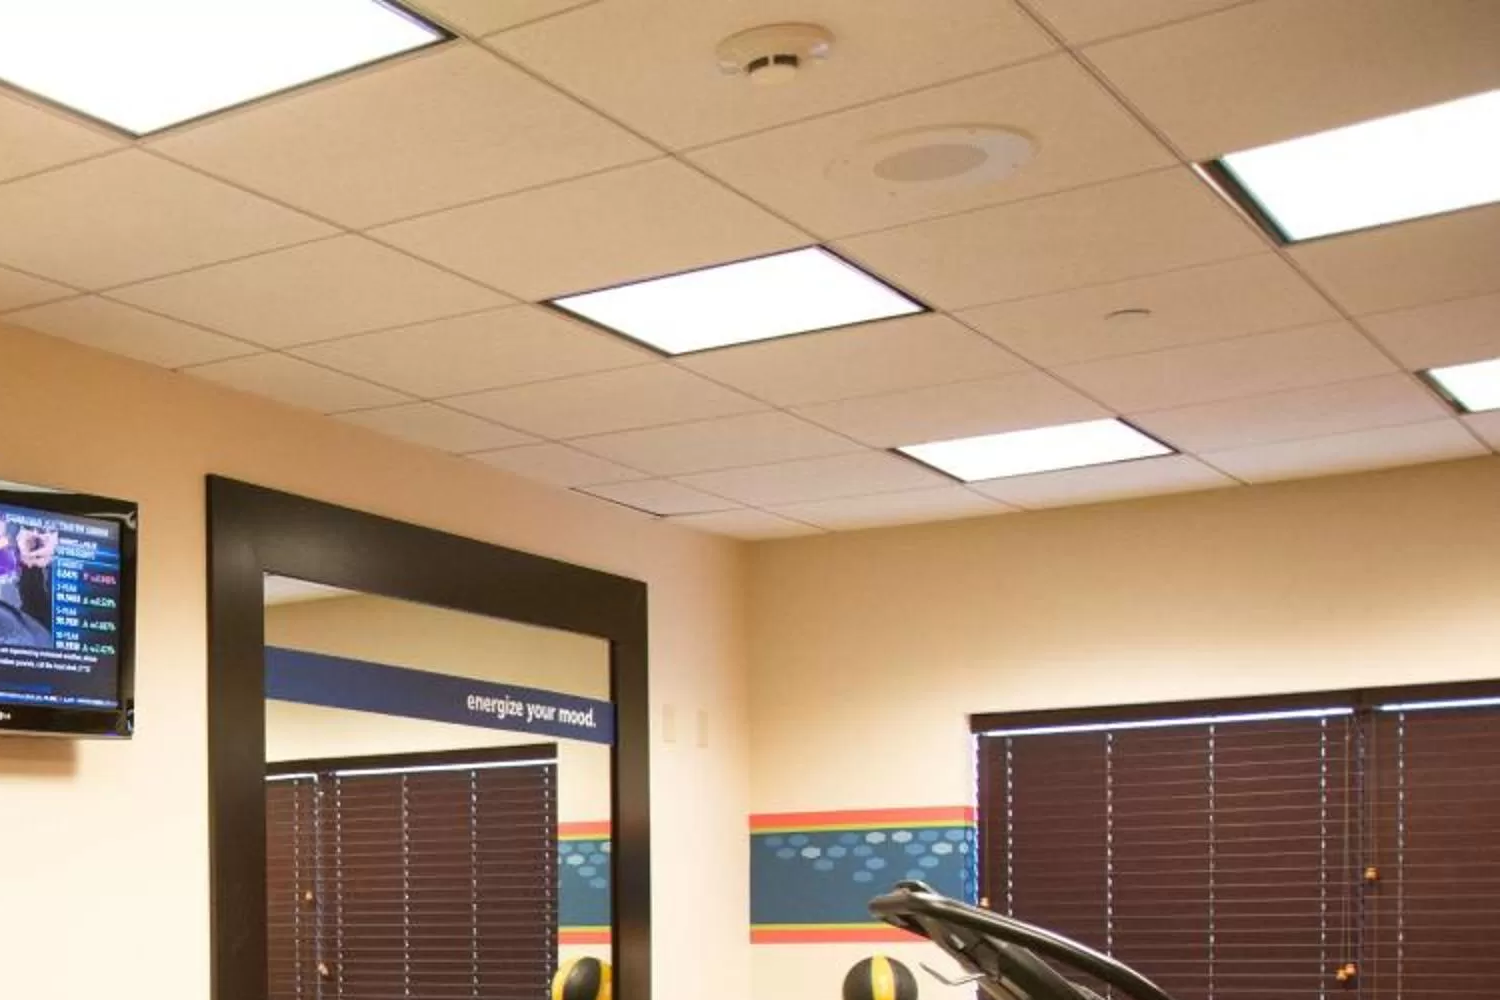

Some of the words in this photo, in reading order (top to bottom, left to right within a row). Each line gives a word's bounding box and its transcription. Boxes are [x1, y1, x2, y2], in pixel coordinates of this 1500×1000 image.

[467, 693, 523, 719] energize
[526, 702, 556, 723] your
[558, 705, 597, 729] mood.
